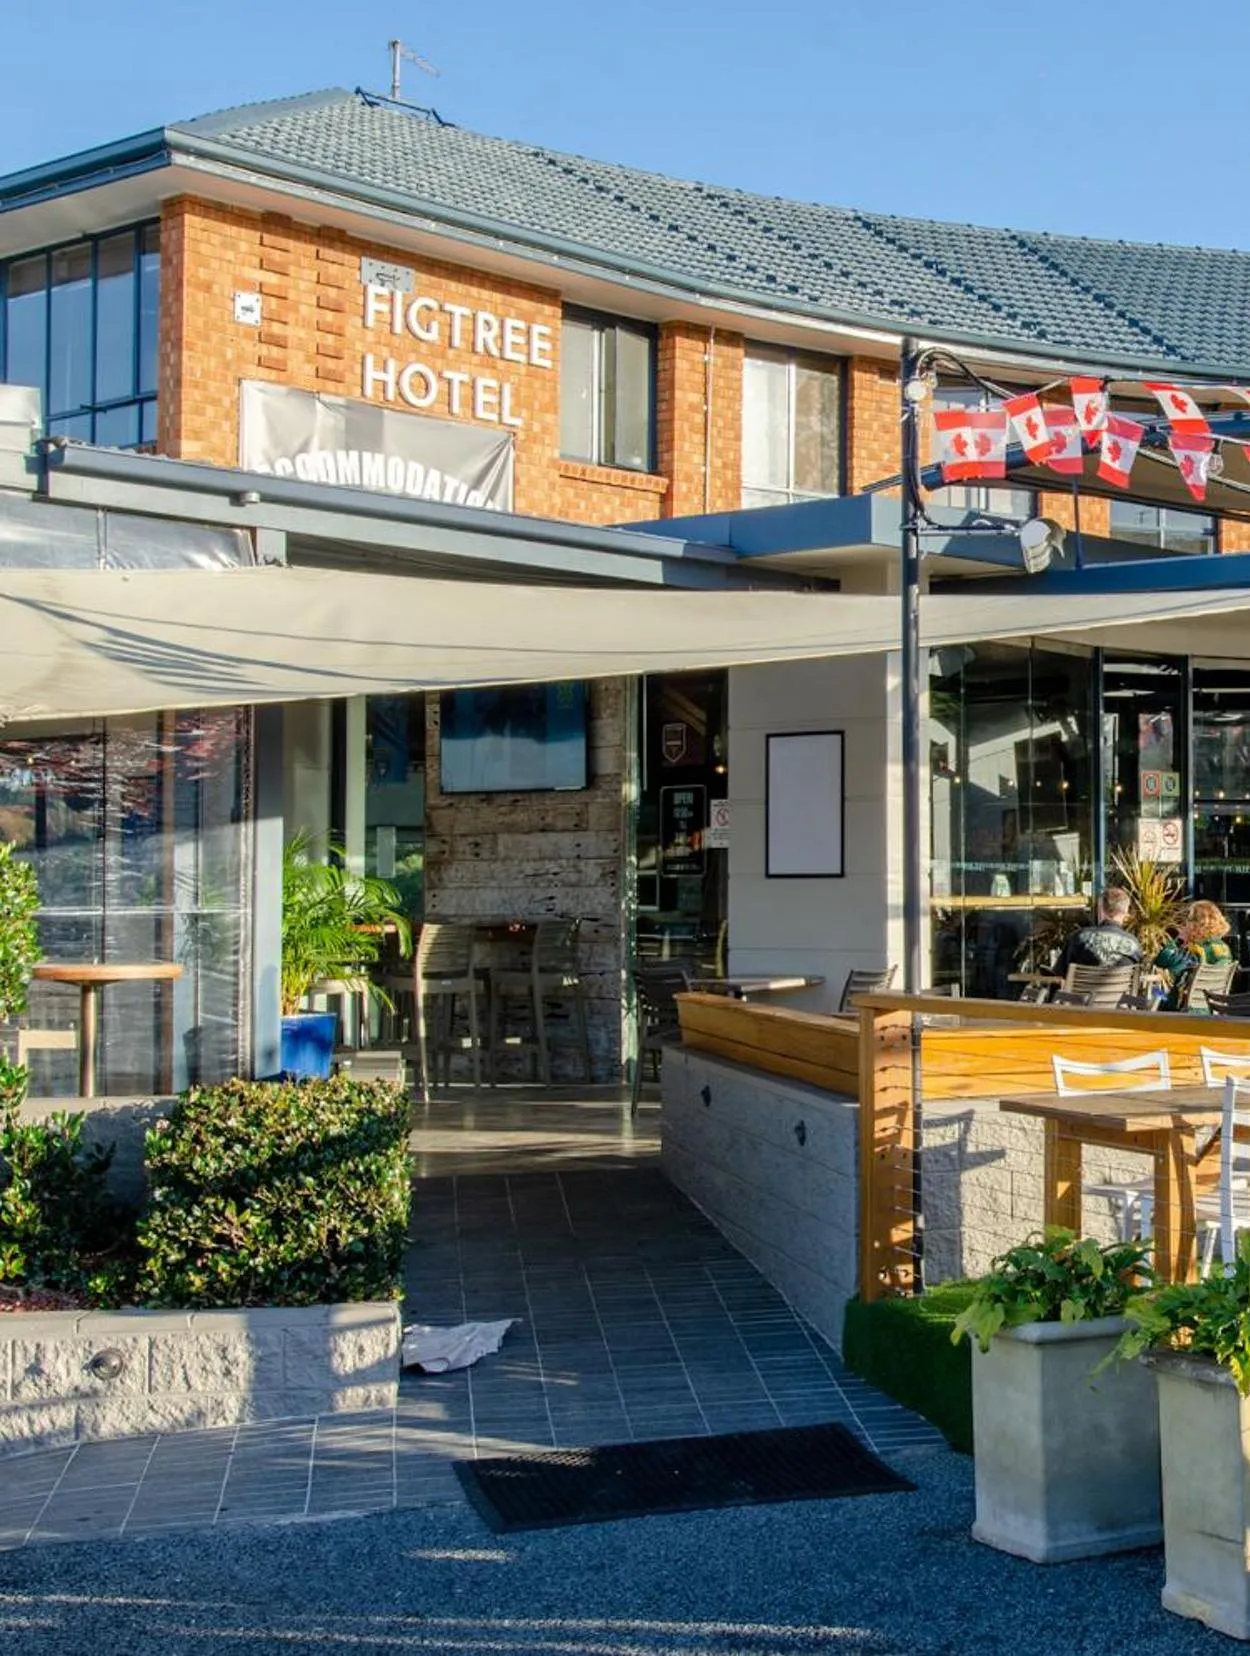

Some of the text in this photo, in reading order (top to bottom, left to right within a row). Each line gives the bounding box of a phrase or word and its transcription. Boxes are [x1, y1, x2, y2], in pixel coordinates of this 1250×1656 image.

[363, 284, 553, 369] FIGTREE
[362, 352, 524, 427] HOTEL
[251, 450, 502, 511] CCOMMODATIO
